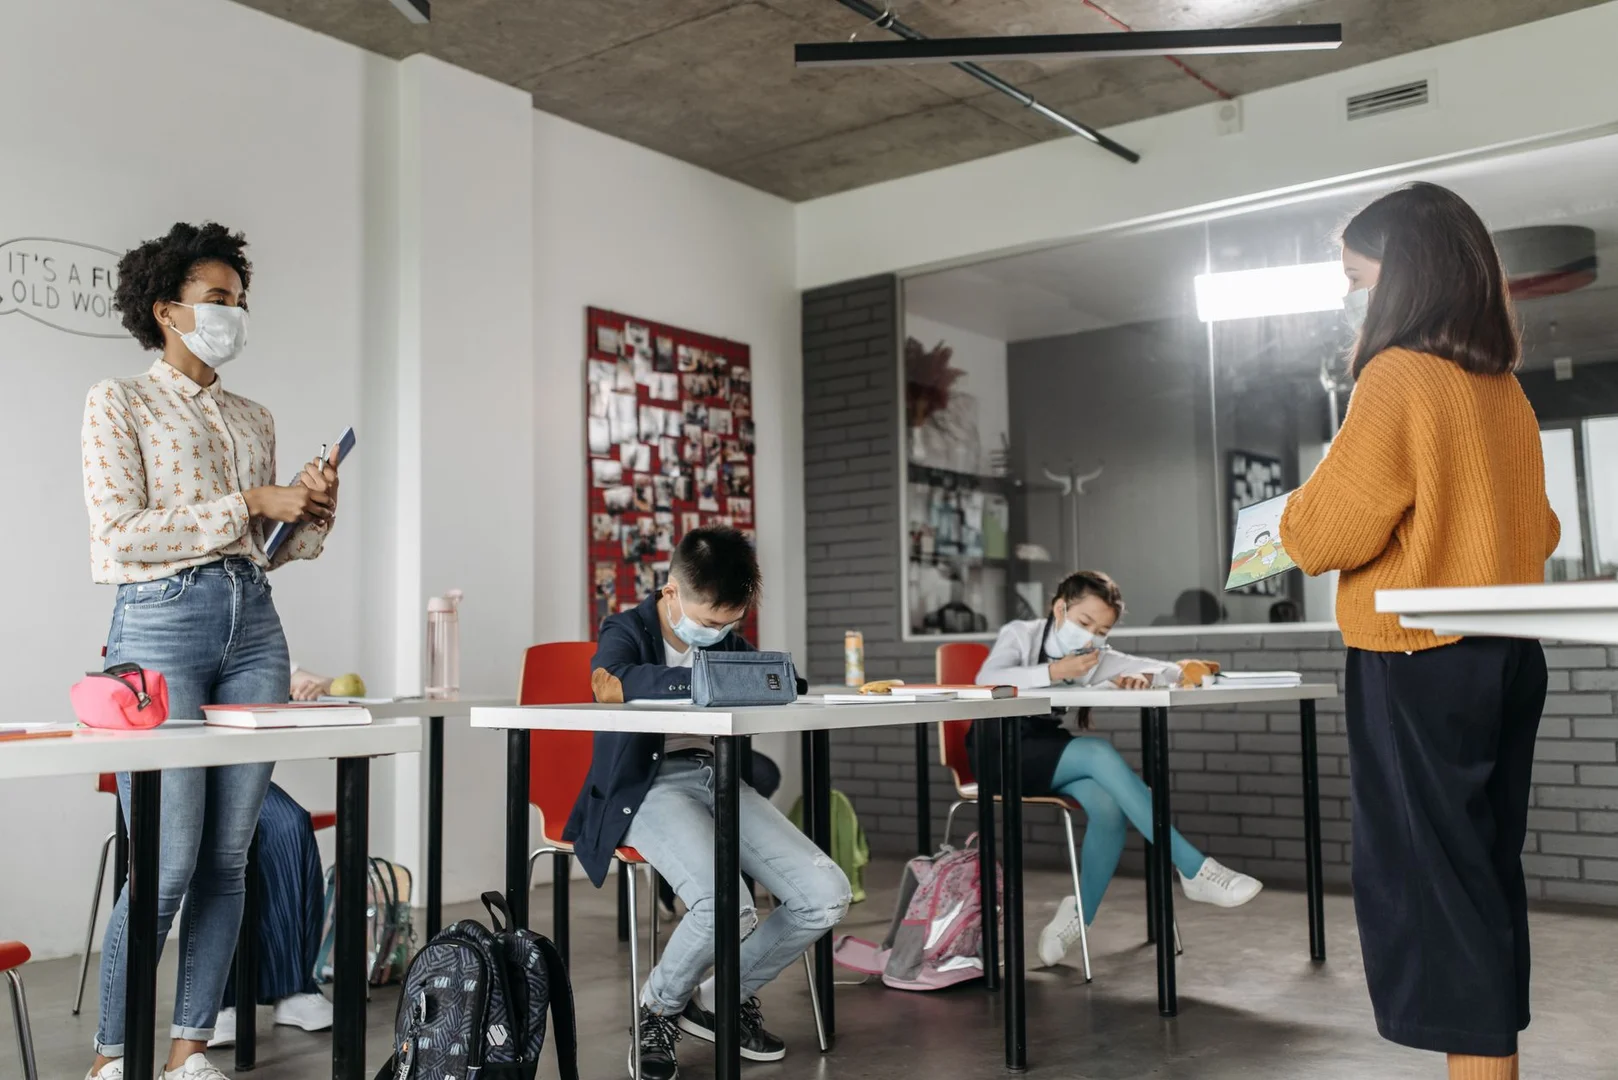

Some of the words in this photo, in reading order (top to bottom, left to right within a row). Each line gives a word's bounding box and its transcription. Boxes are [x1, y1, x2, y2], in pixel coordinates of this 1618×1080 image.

[8, 251, 57, 283] IT'S
[68, 262, 82, 285] A
[92, 266, 120, 292] FU
[12, 279, 60, 309] OLD
